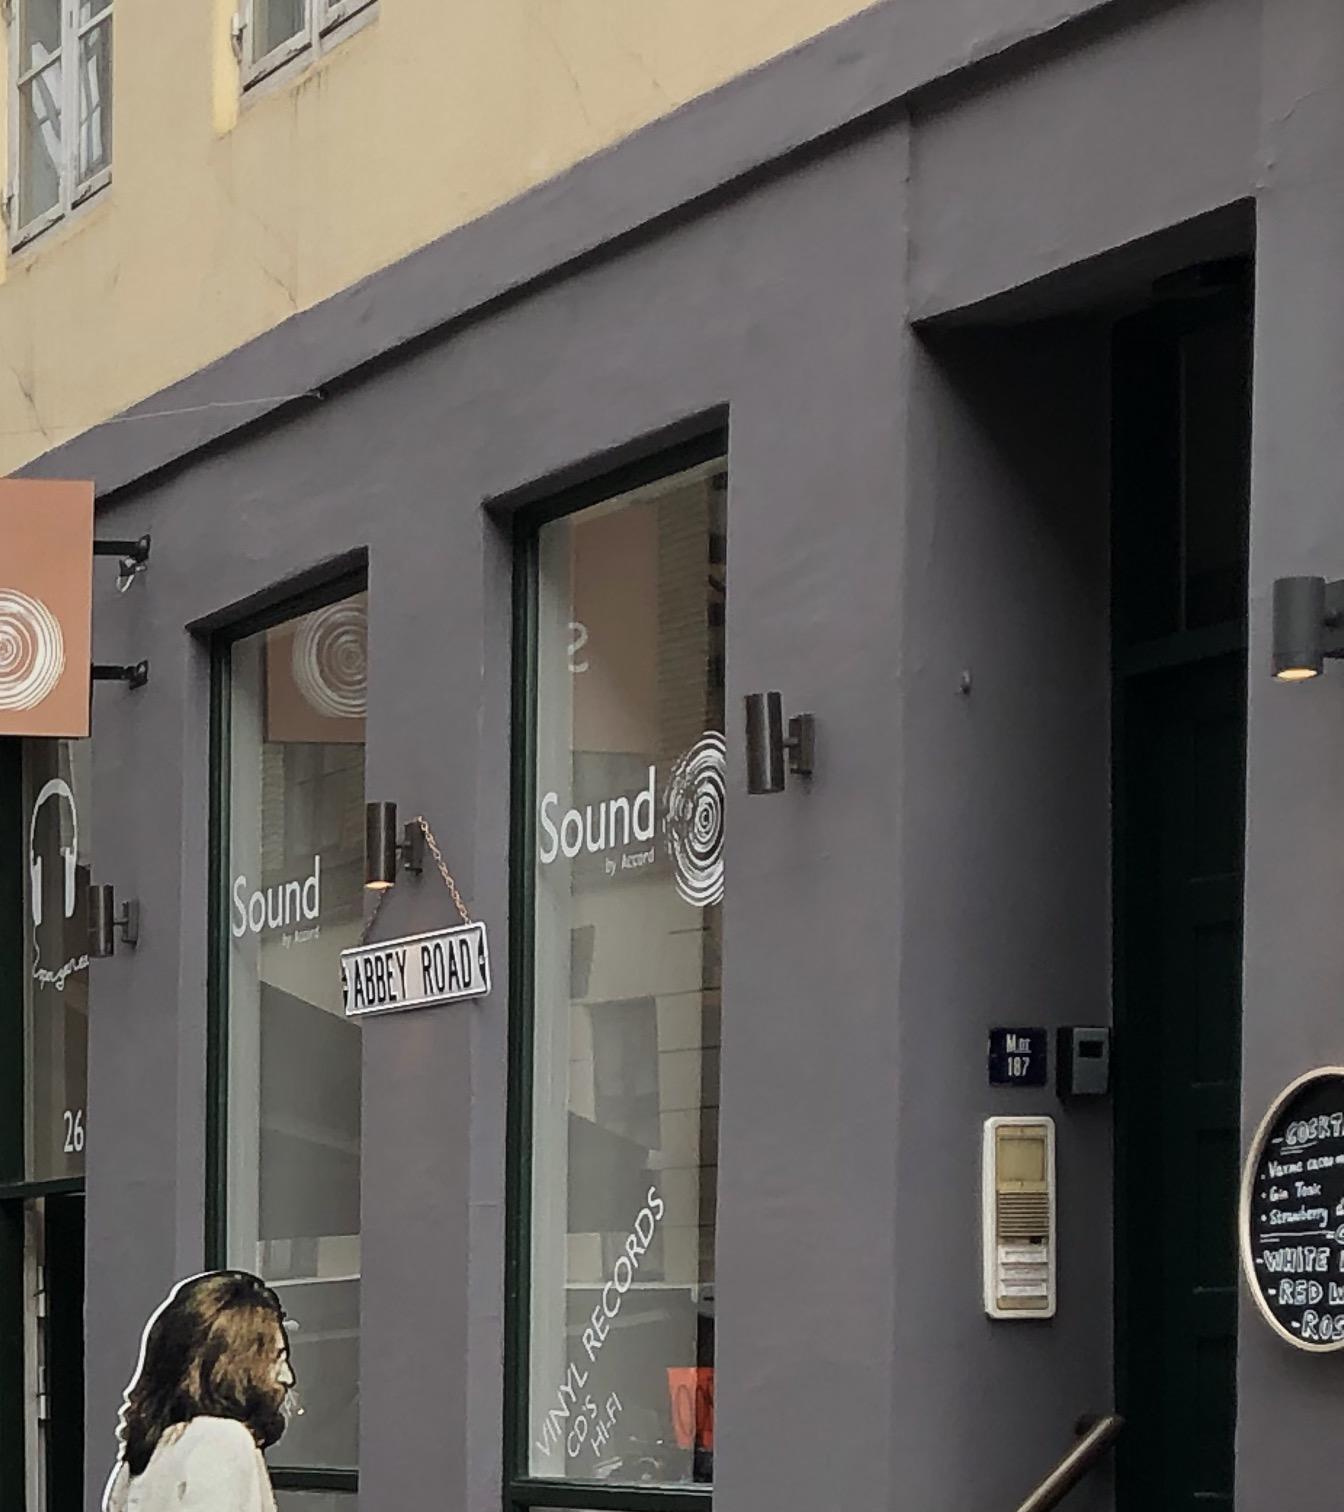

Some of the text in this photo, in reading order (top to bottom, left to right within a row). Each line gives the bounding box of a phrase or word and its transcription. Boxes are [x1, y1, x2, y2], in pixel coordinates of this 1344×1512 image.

[539, 765, 656, 864] Sound
[232, 855, 320, 937] Sound
[354, 938, 472, 1008] ABBEY ROAD
[1007, 1056, 1031, 1077] 187
[63, 1109, 84, 1151] 26
[536, 1187, 664, 1456] VINYL RECORDS
[590, 1392, 623, 1457] HI-FI
